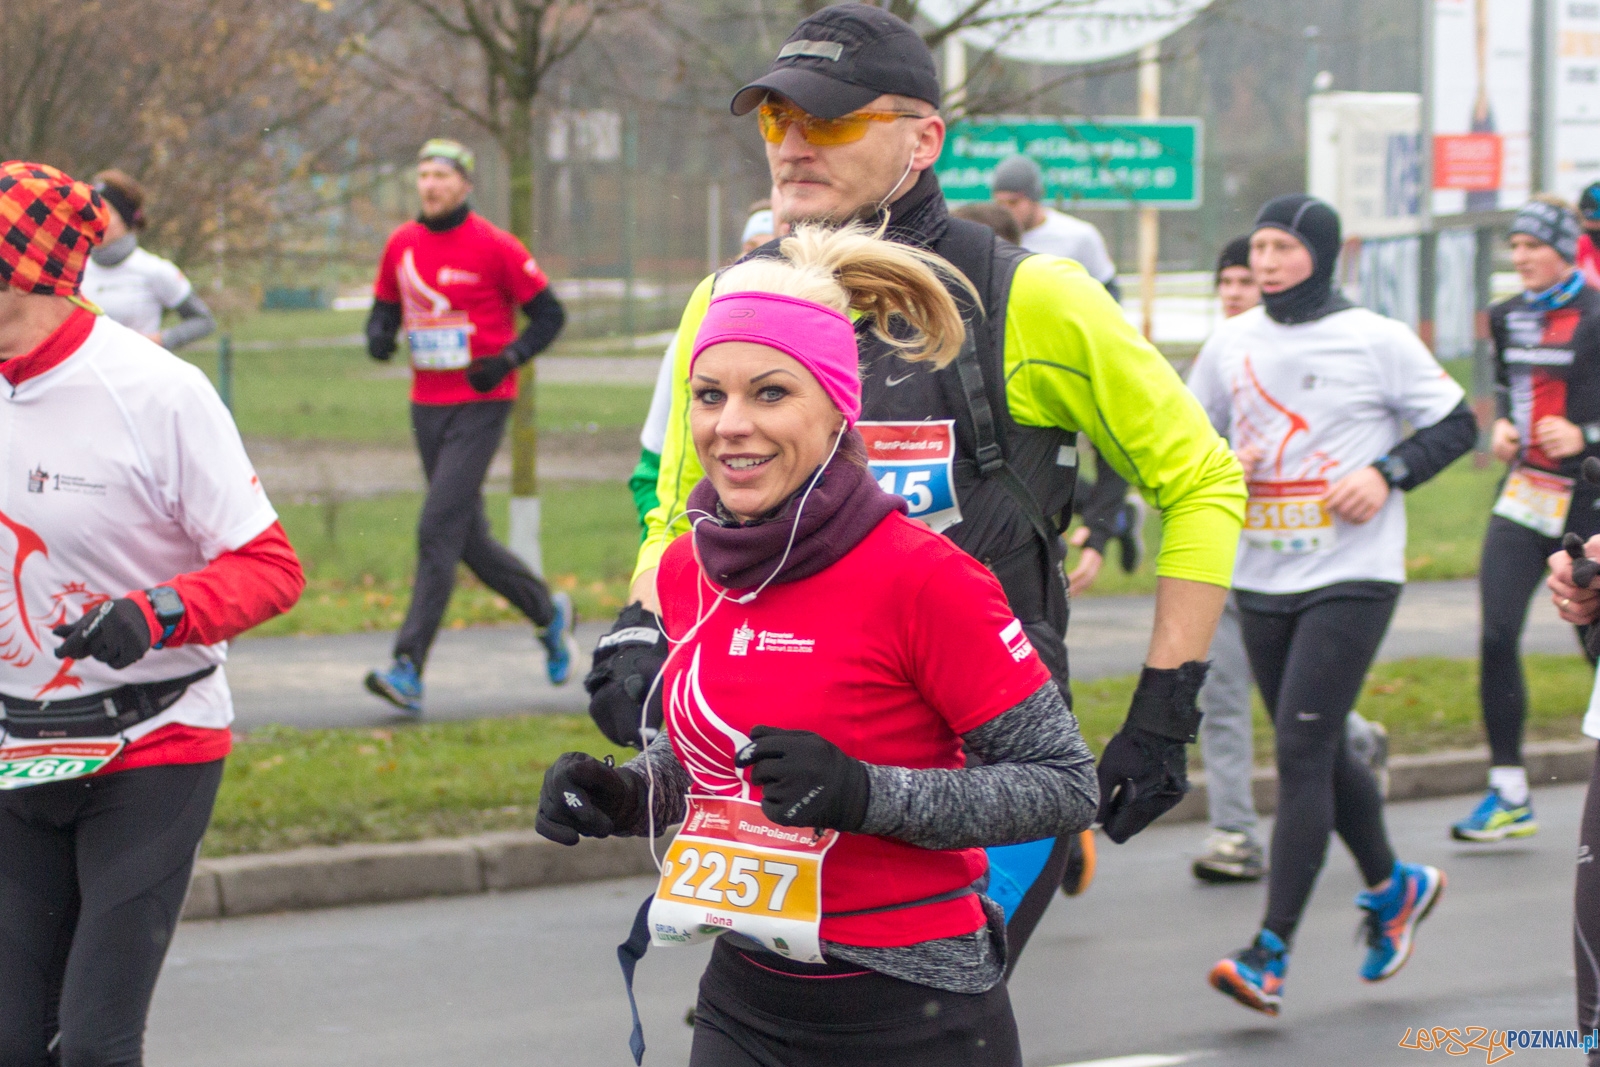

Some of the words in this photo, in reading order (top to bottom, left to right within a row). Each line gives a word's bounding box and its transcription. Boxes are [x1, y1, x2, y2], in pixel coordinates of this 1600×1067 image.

[1249, 504, 1322, 527] 5168
[738, 820, 817, 846] RunPoland.org
[670, 848, 798, 912] 2257
[655, 923, 678, 935] GRUPA
[705, 912, 733, 927] Ilona
[657, 932, 687, 943] LUXMED
